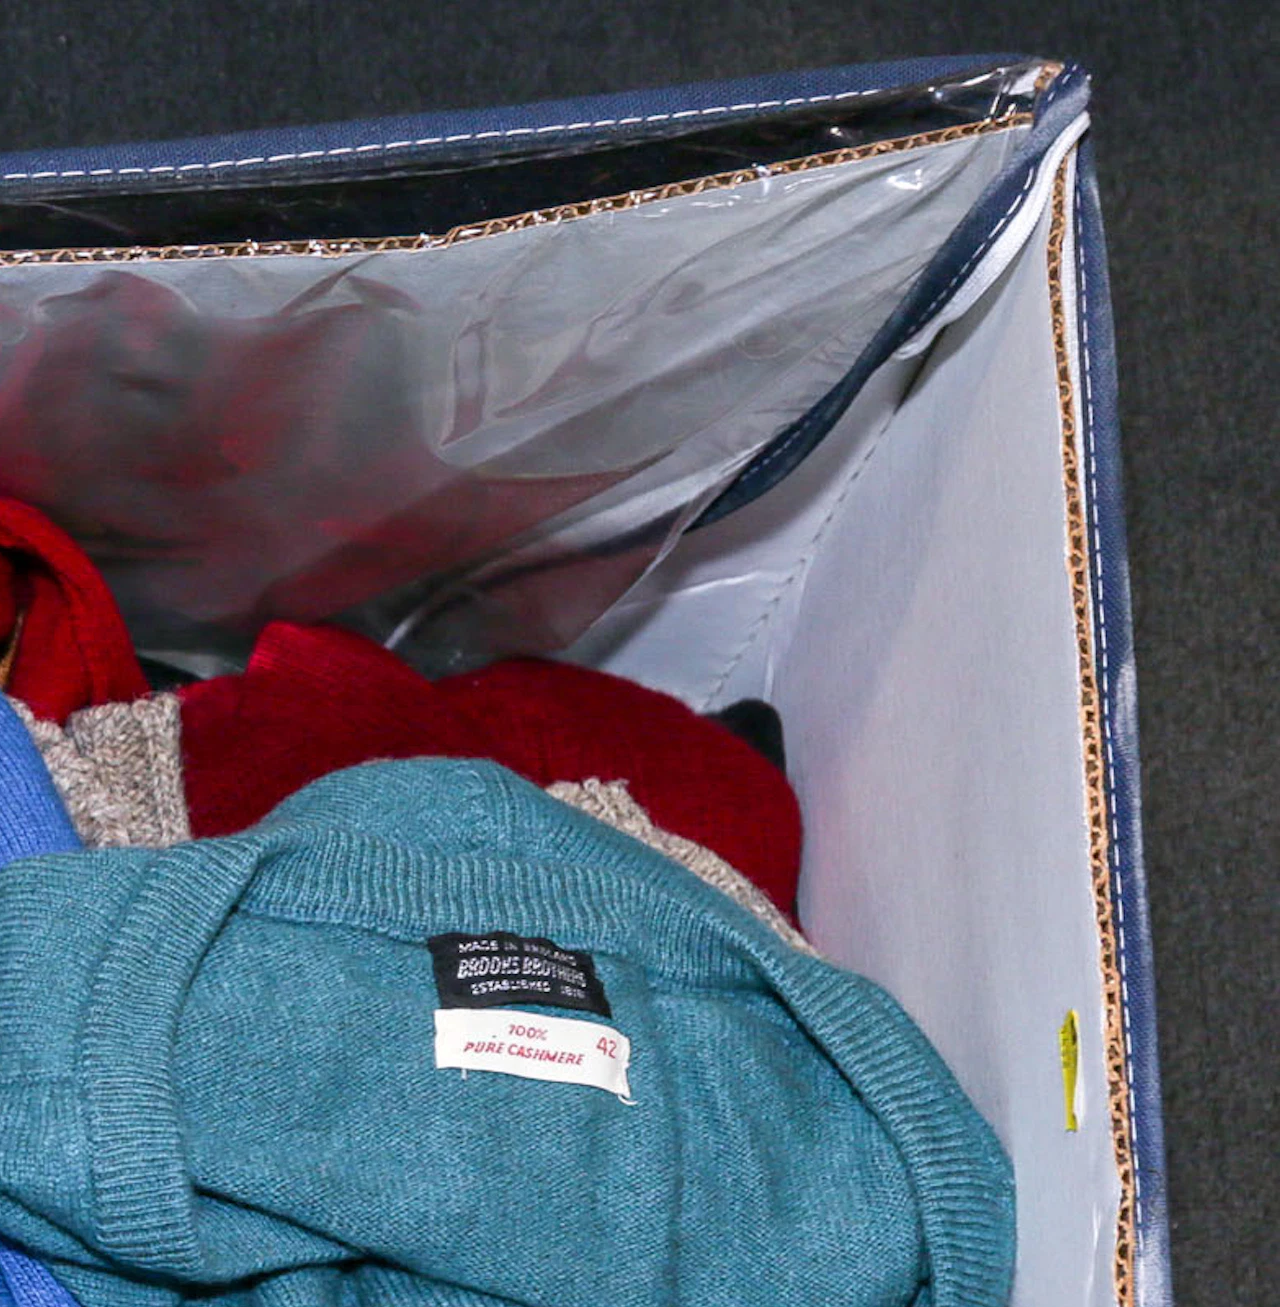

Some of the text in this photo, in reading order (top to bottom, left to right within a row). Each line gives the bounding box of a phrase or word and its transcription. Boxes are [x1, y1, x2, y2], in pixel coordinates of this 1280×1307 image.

[508, 1024, 548, 1040] 100%
[463, 1041, 585, 1066] PURE CASHMERE
[596, 1036, 618, 1059] 42
